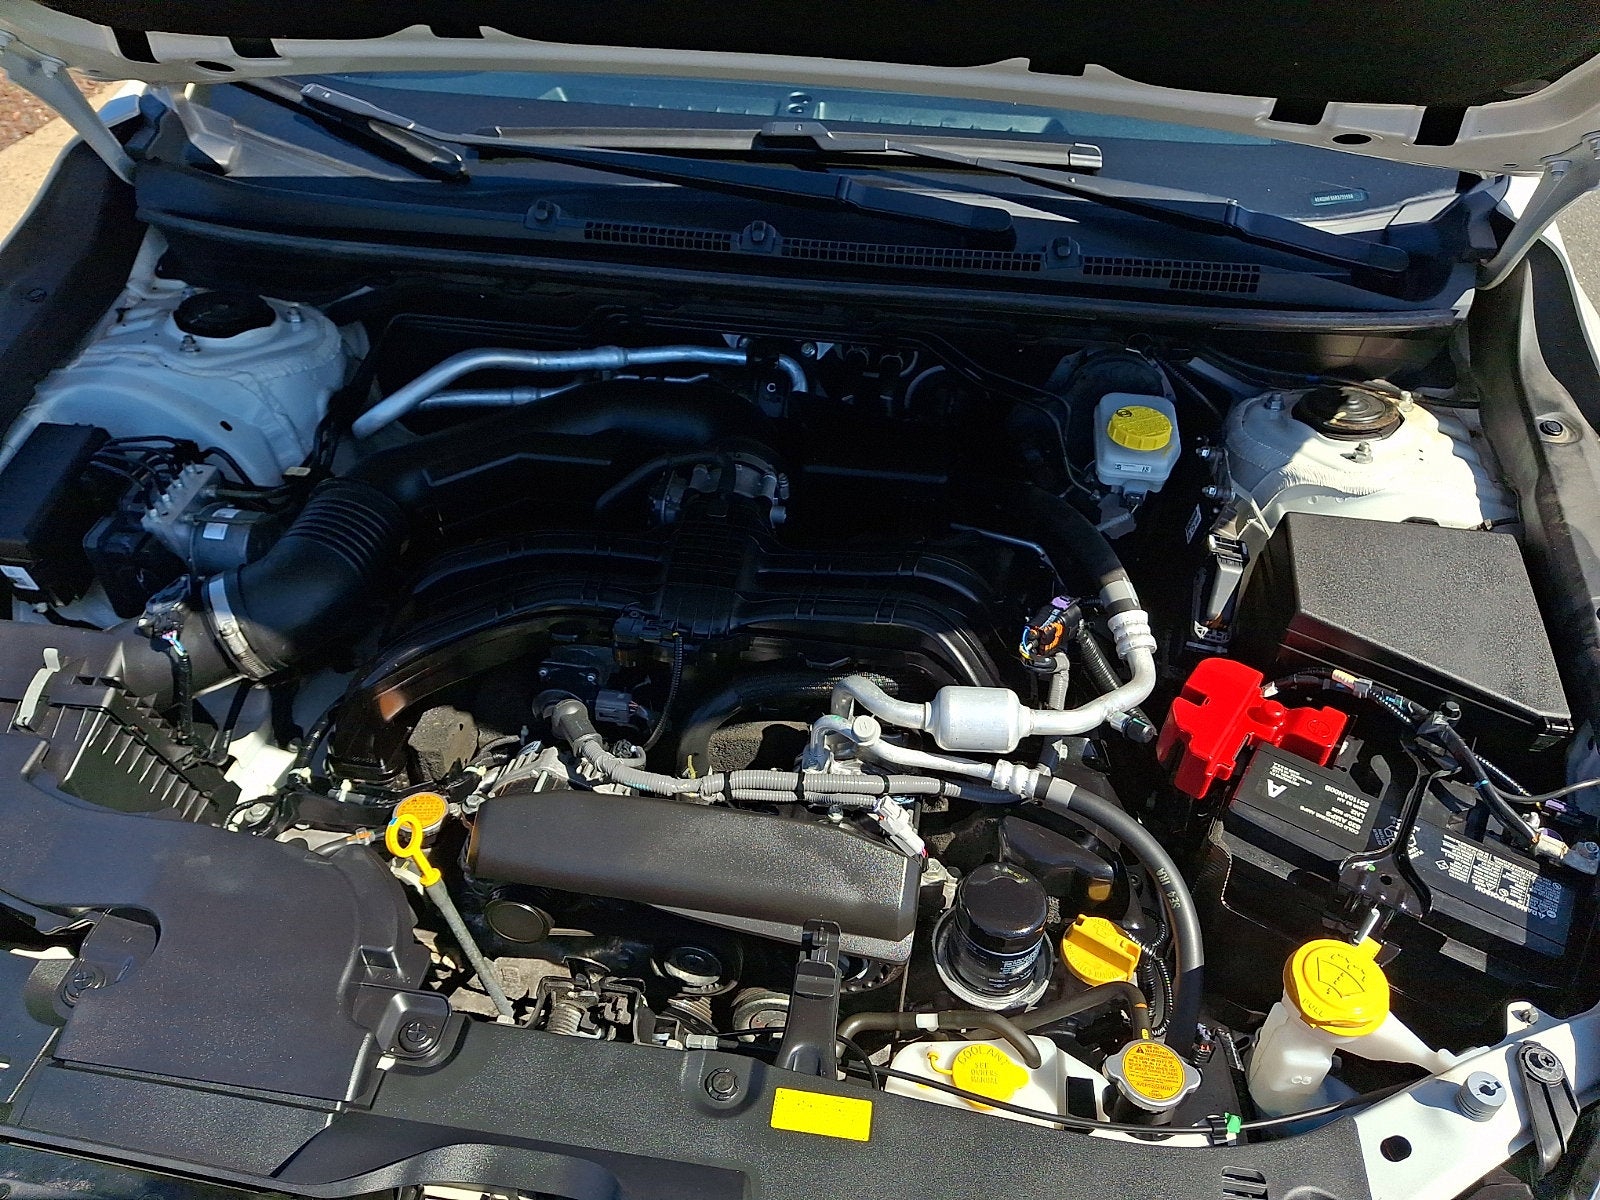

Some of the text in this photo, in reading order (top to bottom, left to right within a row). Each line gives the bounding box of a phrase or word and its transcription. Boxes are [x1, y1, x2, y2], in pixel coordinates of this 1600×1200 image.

[1299, 805, 1315, 815] AMPS
[1325, 811, 1347, 823] AMPS
[1344, 824, 1360, 835] COLD
